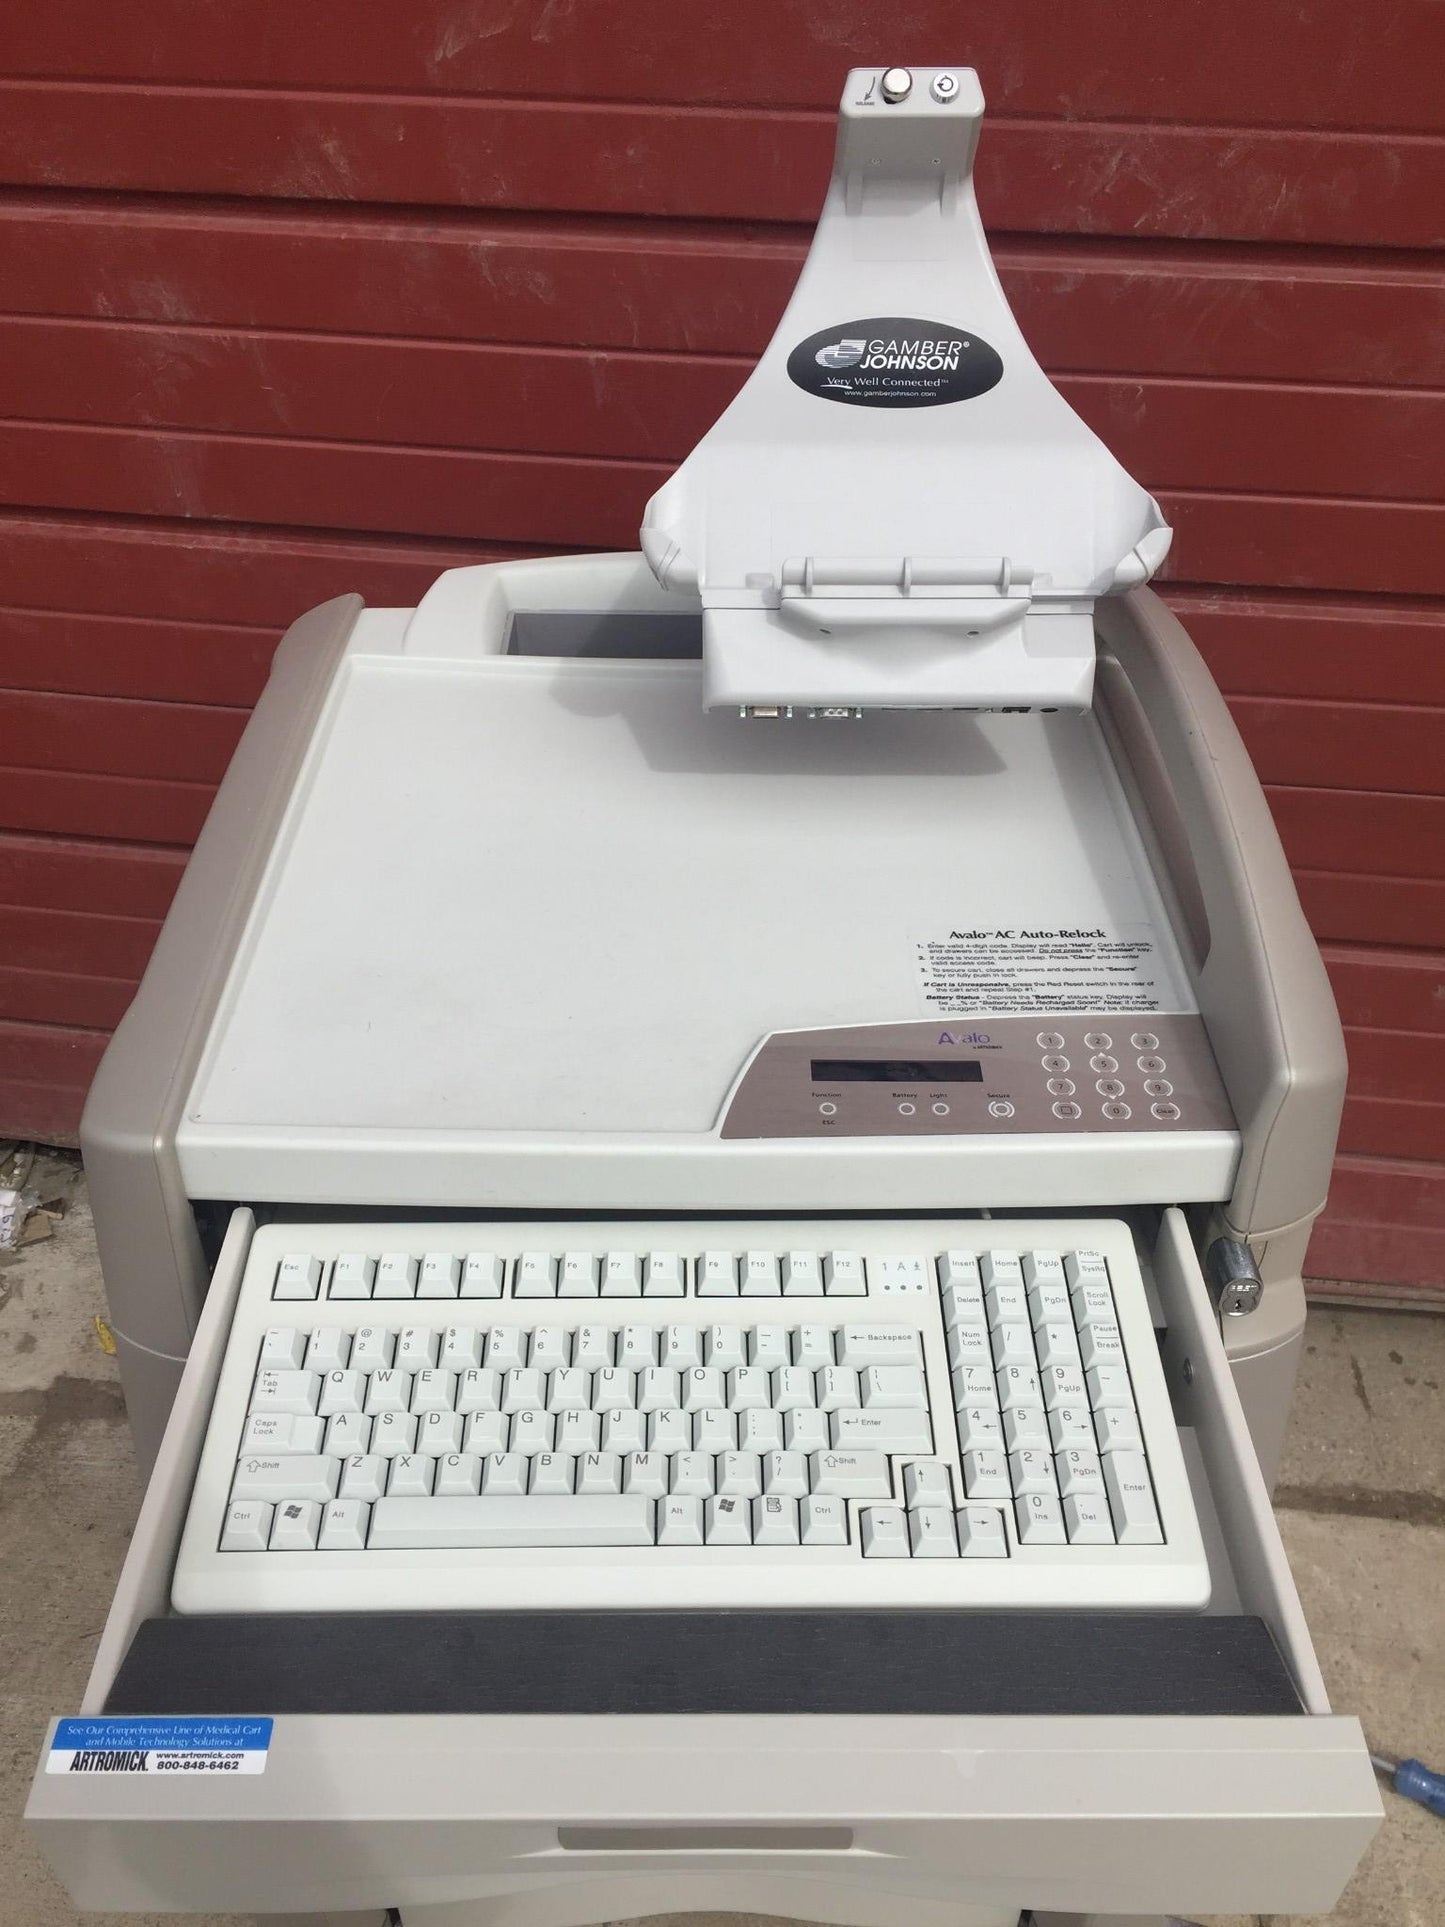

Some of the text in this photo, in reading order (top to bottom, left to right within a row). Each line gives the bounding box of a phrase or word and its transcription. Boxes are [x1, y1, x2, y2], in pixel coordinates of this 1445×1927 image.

[860, 355, 959, 370] JOHNSON
[827, 377, 851, 387] Very
[854, 377, 879, 386] Well
[844, 390, 937, 398] www.gamberjohnson.com
[995, 930, 1015, 939] AC
[1020, 929, 1107, 939] Auto-Relock
[284, 1263, 299, 1271] Esc
[897, 1262, 906, 1271] A
[1037, 1259, 1059, 1268] PgUp
[957, 1296, 980, 1304] Delete
[1000, 1296, 1016, 1304] End
[1086, 1291, 1108, 1299] Scroll
[1044, 1296, 1067, 1305] PgDn
[868, 1334, 912, 1342] Backspace
[314, 1342, 318, 1351] 1
[358, 1342, 366, 1350] 2
[403, 1342, 410, 1350] 3
[448, 1342, 455, 1350] 4
[493, 1342, 500, 1350] 5
[537, 1342, 544, 1350] 6
[582, 1341, 589, 1349] 7
[627, 1341, 634, 1349] 8
[672, 1341, 678, 1349] 9
[716, 1341, 723, 1349] 0
[1096, 1341, 1120, 1349] Break
[331, 1371, 344, 1383] Q
[376, 1370, 393, 1382] W
[422, 1370, 432, 1382] E
[467, 1370, 478, 1382] R
[513, 1370, 523, 1381] T
[559, 1369, 570, 1380] Y
[603, 1369, 614, 1380] U
[650, 1369, 654, 1380] I
[694, 1369, 706, 1380] O
[738, 1369, 749, 1380] P
[966, 1368, 974, 1378] 7
[1010, 1368, 1019, 1378] 8
[1055, 1368, 1065, 1378] 9
[262, 1379, 278, 1387] Tab
[967, 1384, 992, 1392] Home
[1058, 1384, 1081, 1393] PgUp
[336, 1414, 347, 1426] A
[383, 1413, 394, 1425] S
[429, 1413, 441, 1424] D
[475, 1413, 486, 1423] F
[522, 1412, 534, 1424] G
[567, 1412, 579, 1423] H
[613, 1412, 622, 1422] J
[660, 1411, 671, 1422] K
[706, 1411, 715, 1422] L
[972, 1410, 981, 1420] 4
[1017, 1410, 1026, 1420] 5
[1062, 1410, 1072, 1421] 6
[255, 1419, 277, 1428] Caps
[252, 1428, 274, 1436] Lock
[352, 1456, 364, 1468] Z
[400, 1456, 412, 1468] X
[448, 1455, 460, 1467] C
[494, 1455, 505, 1466] V
[541, 1455, 552, 1466] B
[588, 1454, 600, 1466] N
[635, 1454, 649, 1465] M
[838, 1457, 856, 1465] Shift
[978, 1452, 984, 1462] 1
[1023, 1452, 1033, 1462] 2
[1071, 1452, 1080, 1462] 3
[262, 1462, 280, 1470] Shift
[980, 1468, 997, 1476] End
[1072, 1467, 1096, 1477] PgDn
[1124, 1483, 1146, 1491] Enter
[1032, 1496, 1042, 1507] 0
[332, 1510, 345, 1519] Alt
[671, 1506, 683, 1515] Alt
[814, 1506, 831, 1514] Ctrl
[234, 1511, 251, 1521] Ctrl
[1035, 1512, 1048, 1521] Ins
[1081, 1512, 1097, 1521] Del
[68, 1725, 261, 1737] See Our Comprehensive Line of Medical Cart
[86, 1736, 244, 1748] and Mobile Technology Solutions at
[156, 1760, 240, 1770] 800-848-6462
